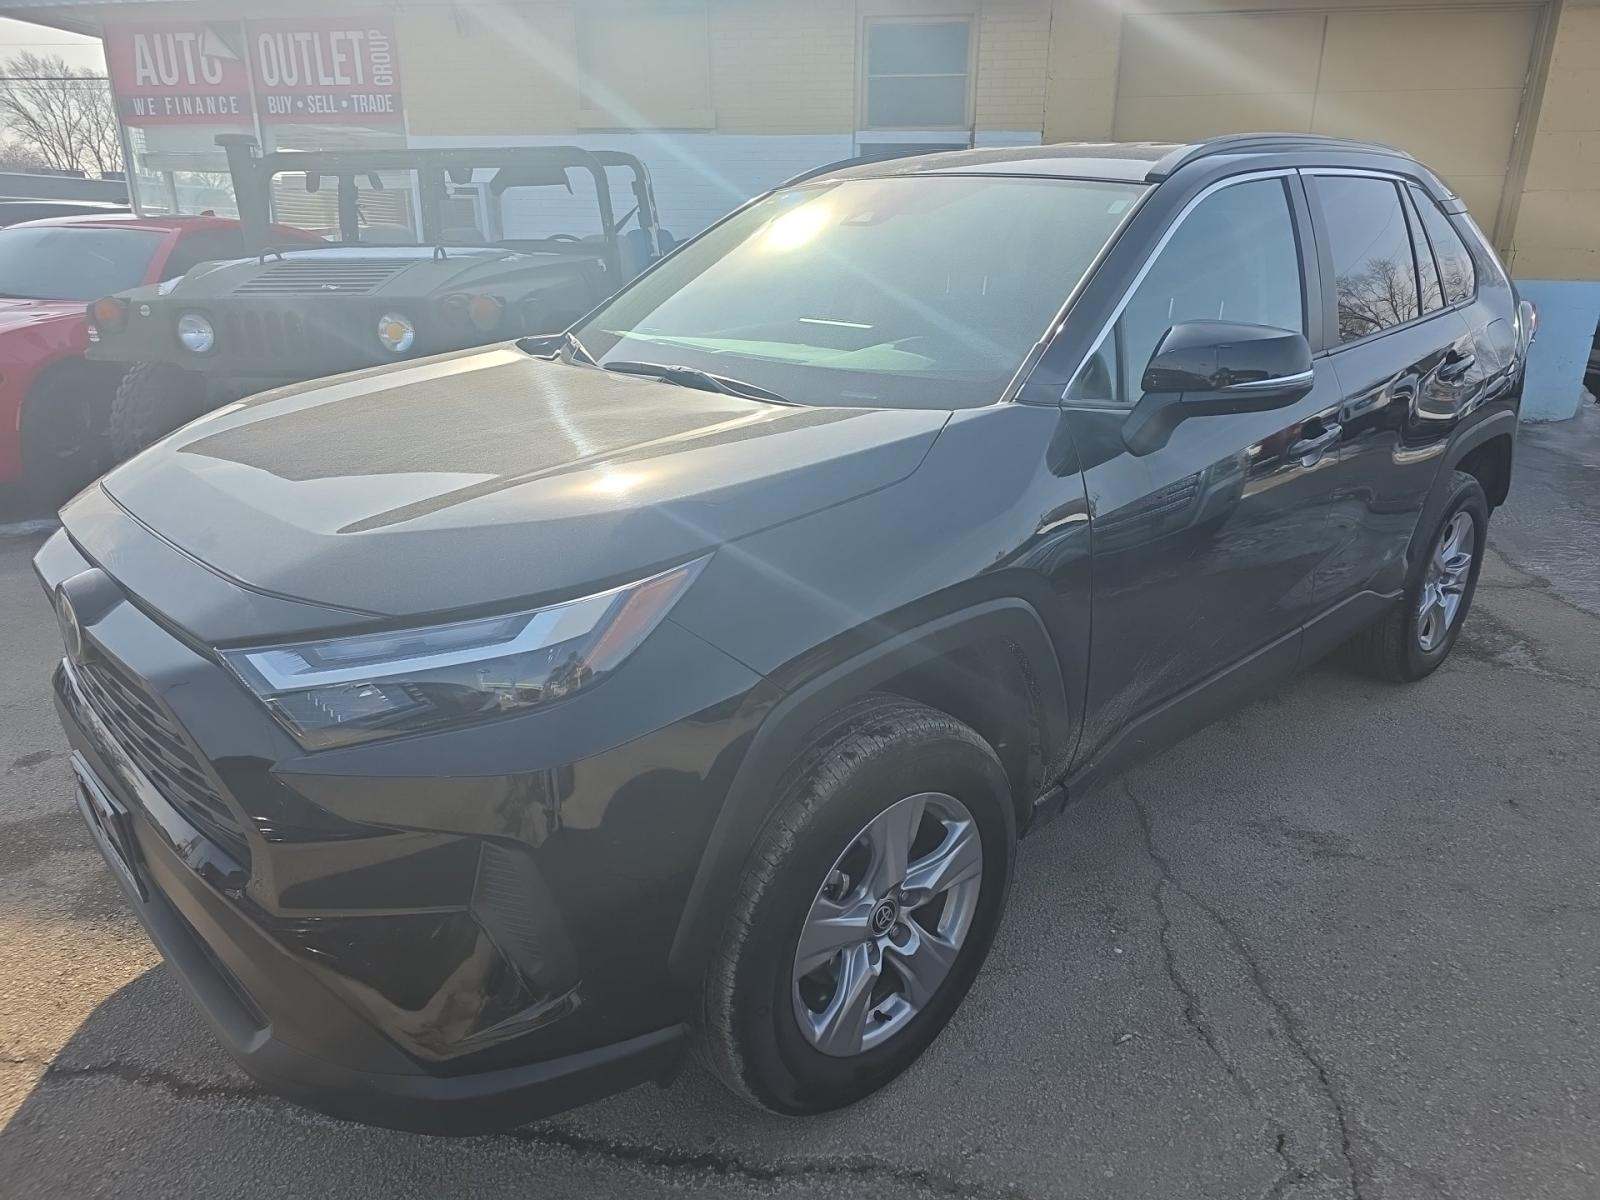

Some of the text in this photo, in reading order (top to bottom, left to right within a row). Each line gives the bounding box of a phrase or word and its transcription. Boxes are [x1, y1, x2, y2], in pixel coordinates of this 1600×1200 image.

[258, 31, 364, 86] OUTLET
[368, 29, 393, 86] GROUP
[133, 96, 239, 116] WE FINANCE
[267, 94, 394, 114] BUY SELL TRADE
